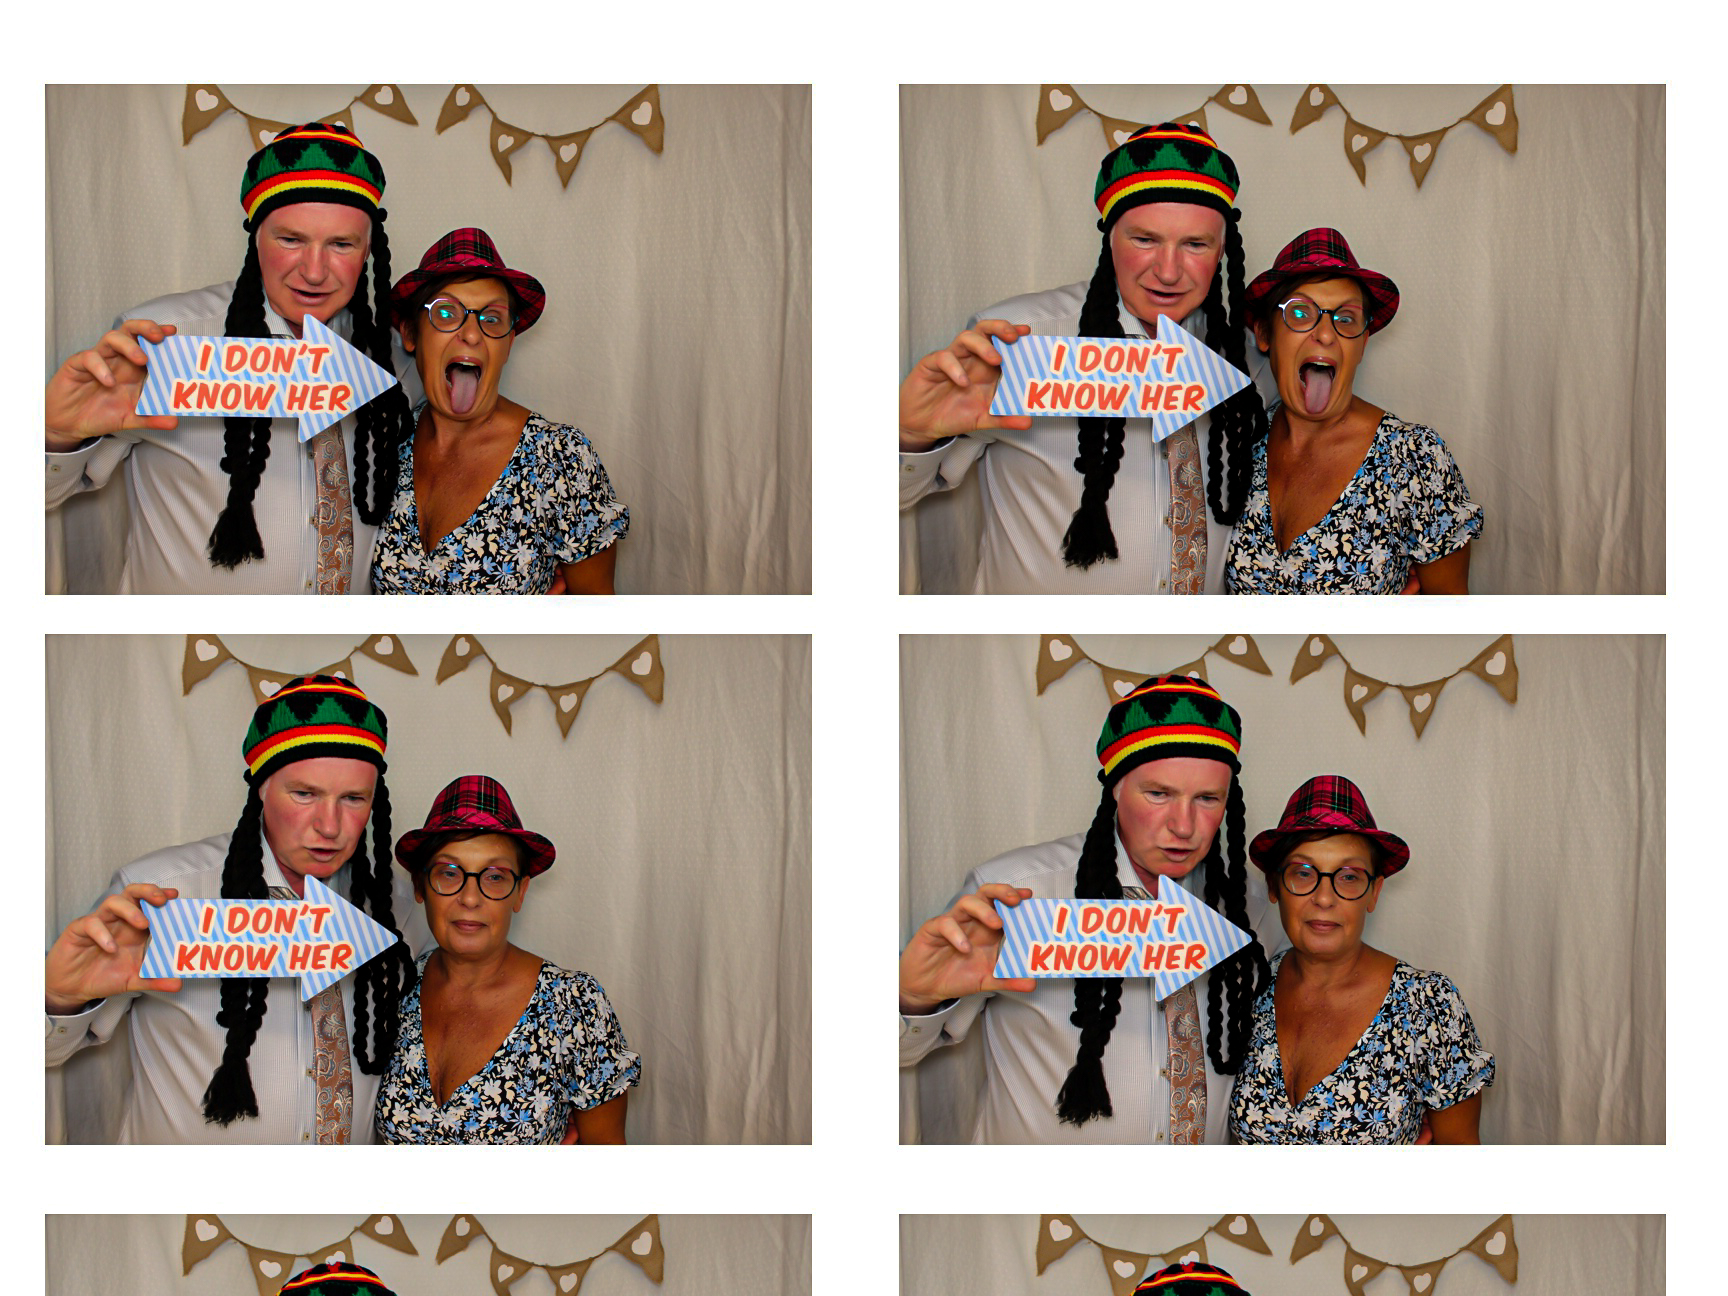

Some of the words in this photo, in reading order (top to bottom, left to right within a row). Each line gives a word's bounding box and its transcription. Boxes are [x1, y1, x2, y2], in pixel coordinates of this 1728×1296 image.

[199, 343, 213, 372] I
[225, 343, 331, 375] DON'T
[1053, 343, 1067, 372] I
[1079, 343, 1185, 375] DON'T
[173, 381, 277, 411] KNOW
[287, 382, 353, 411] HER
[1027, 381, 1131, 411] KNOW
[1141, 382, 1207, 411] HER
[201, 906, 215, 935] I
[227, 903, 331, 935] DON'T
[1055, 906, 1069, 935] I
[1081, 903, 1185, 935] DON'T
[176, 943, 279, 971] KNOW
[289, 943, 353, 971] HER
[1030, 943, 1133, 971] KNOW
[1143, 943, 1207, 971] HER
